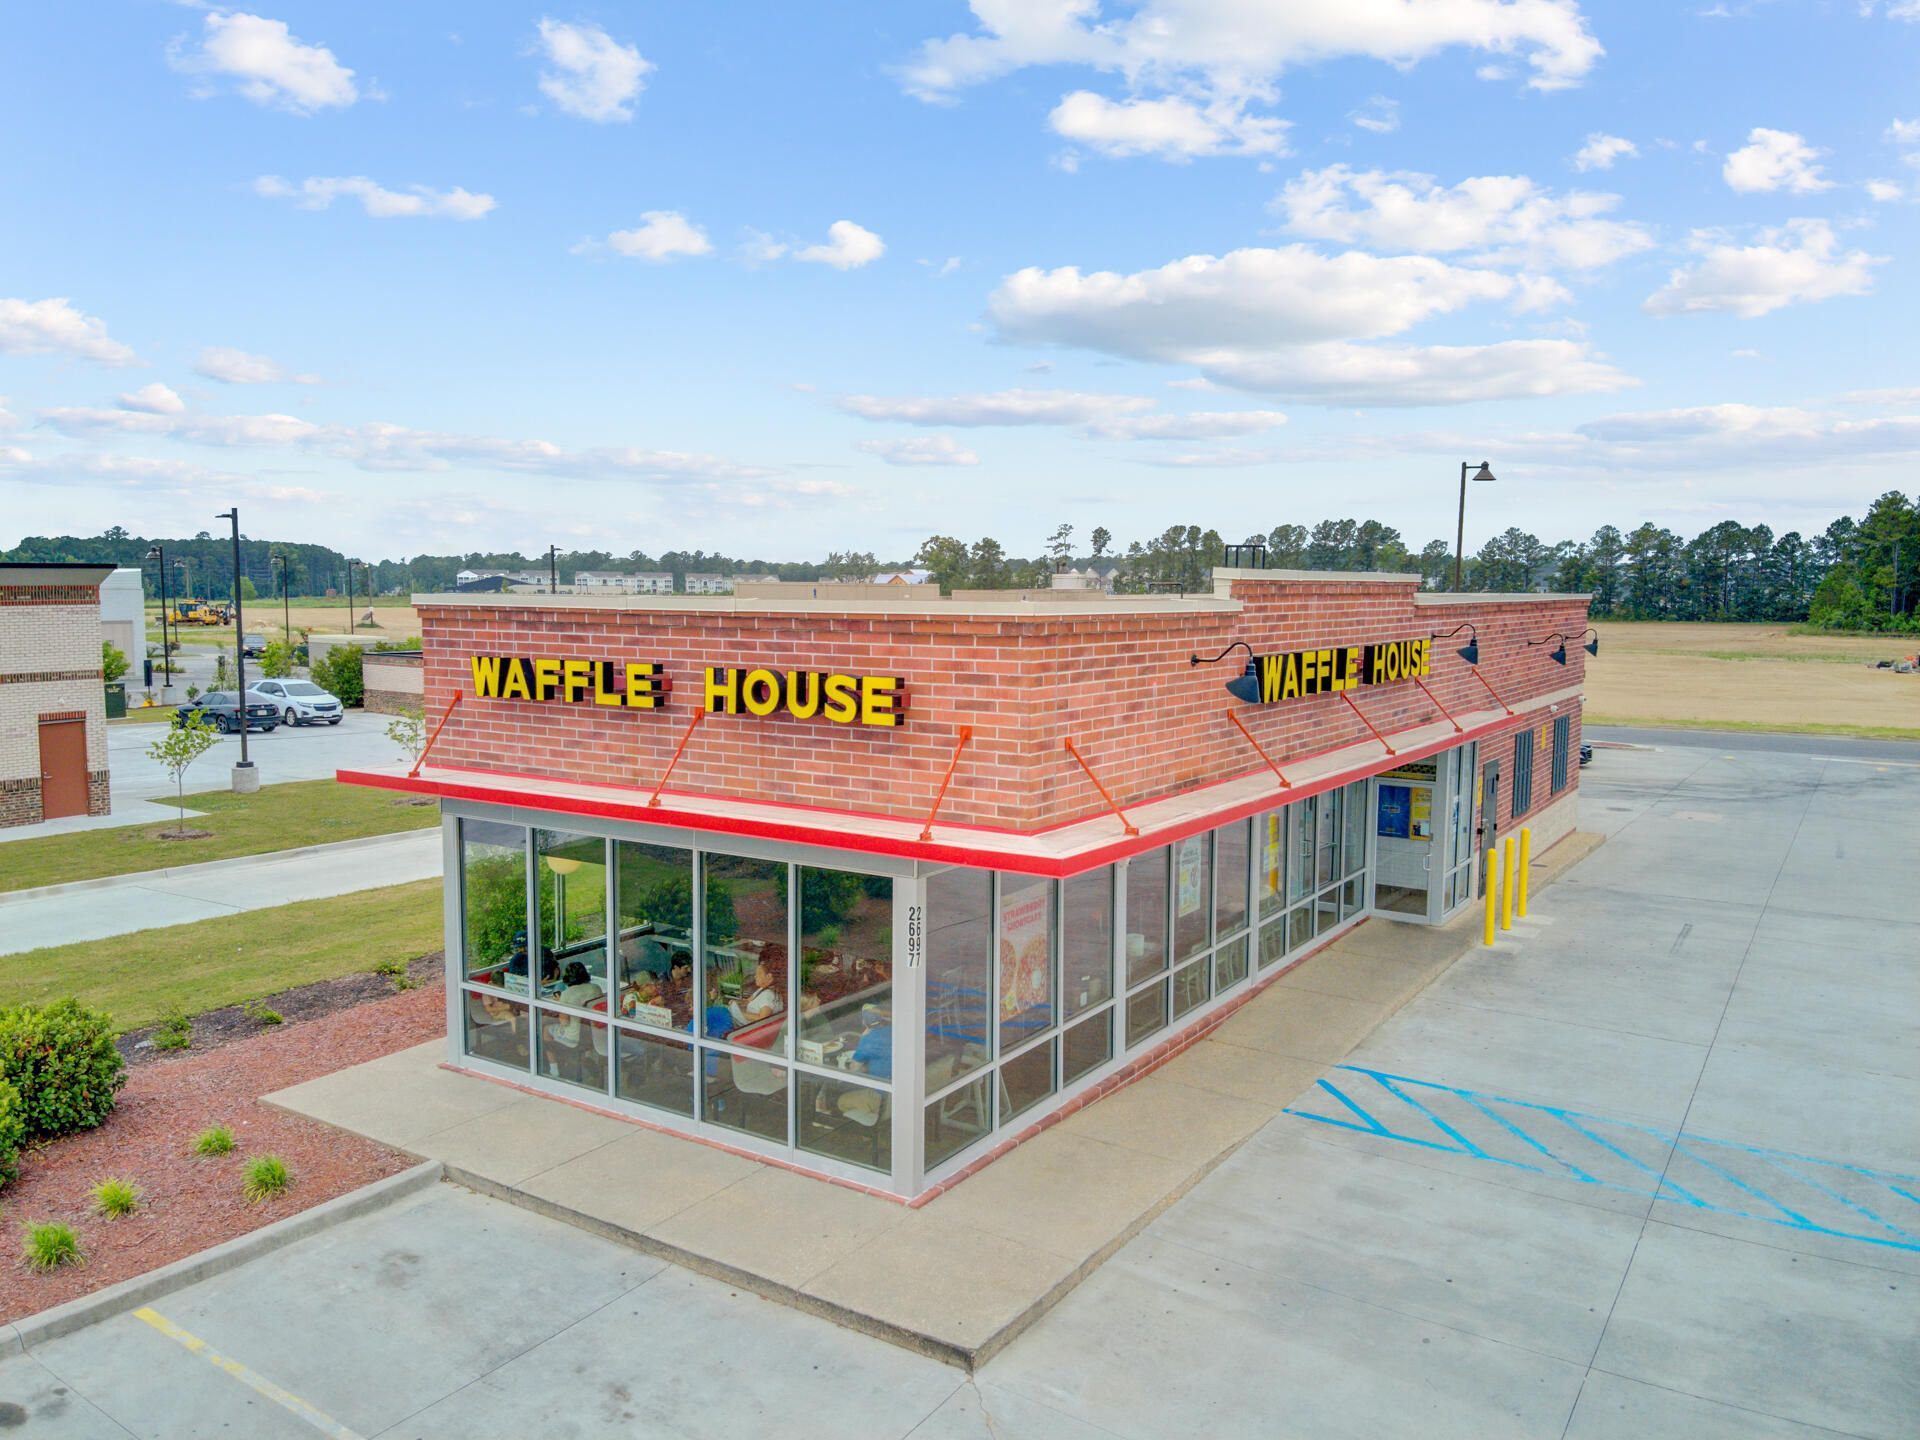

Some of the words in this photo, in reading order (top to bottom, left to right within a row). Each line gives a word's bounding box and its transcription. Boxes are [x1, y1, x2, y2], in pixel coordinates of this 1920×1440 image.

[470, 655, 657, 708] WAFFLE
[704, 666, 898, 727] HOUSE
[1262, 647, 1359, 704] WAFFLE
[1372, 639, 1432, 686] HOUSE
[908, 906, 916, 967] 2697
